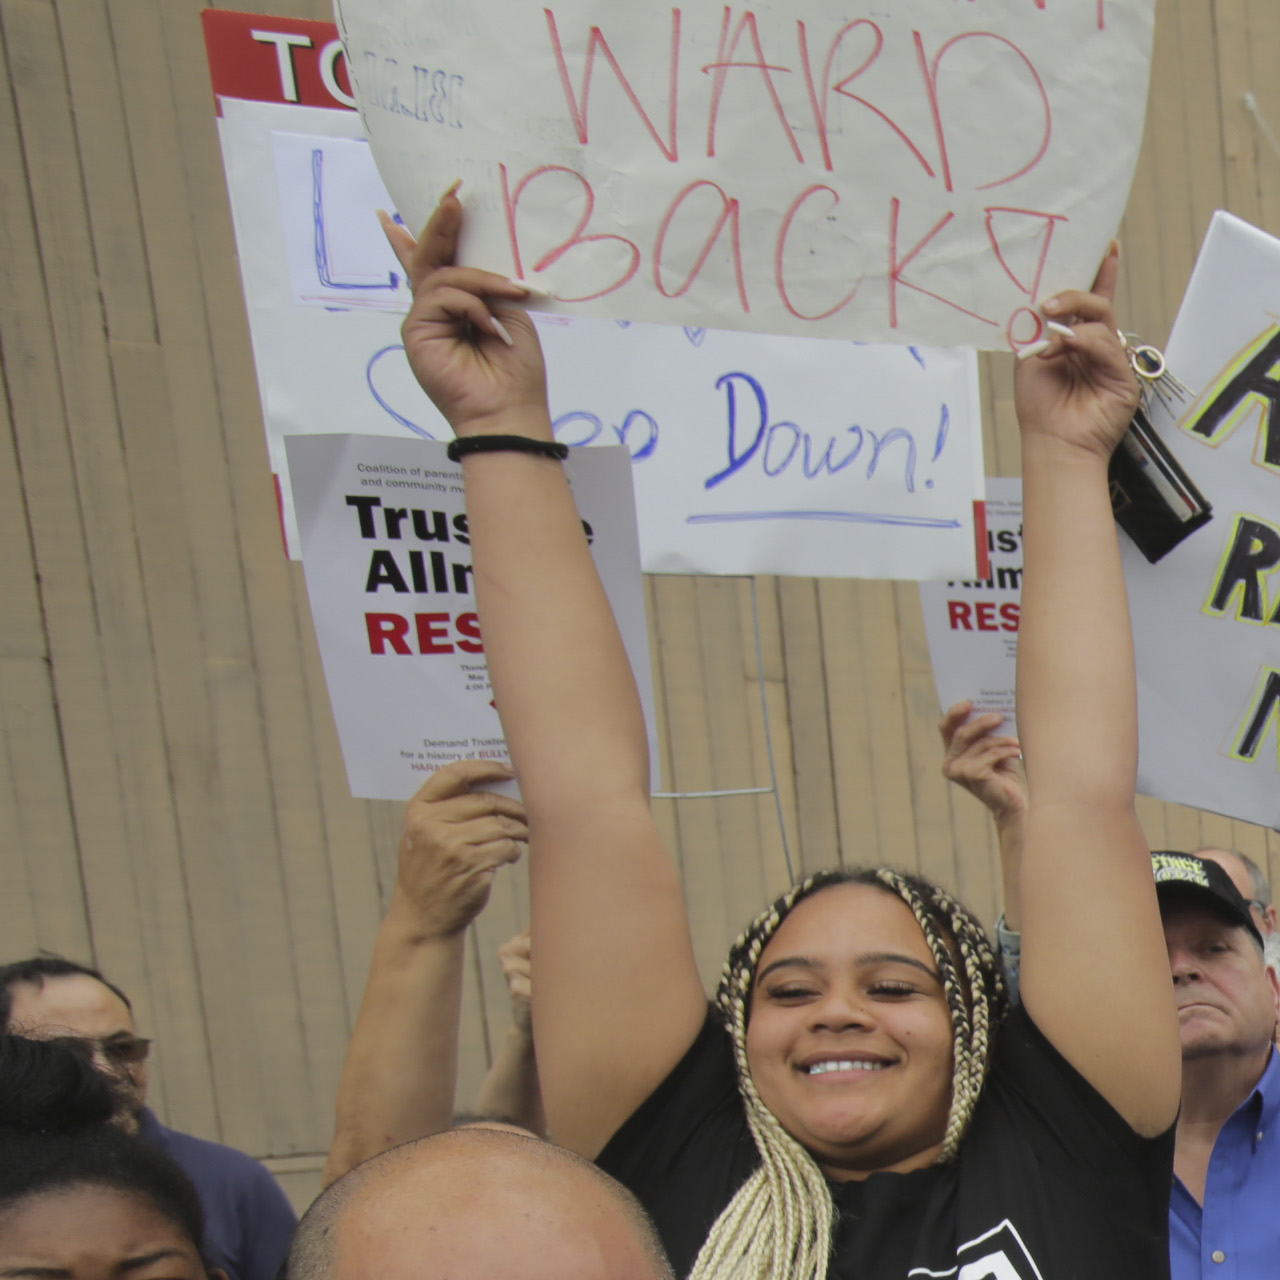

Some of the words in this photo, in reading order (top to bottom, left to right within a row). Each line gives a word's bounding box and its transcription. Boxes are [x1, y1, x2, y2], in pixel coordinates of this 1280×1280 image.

[543, 4, 1053, 193] WARD
[703, 371, 952, 494] Down!
[357, 463, 407, 475] Coalition
[410, 468, 421, 476] of
[361, 478, 382, 487] and
[385, 479, 447, 493] community
